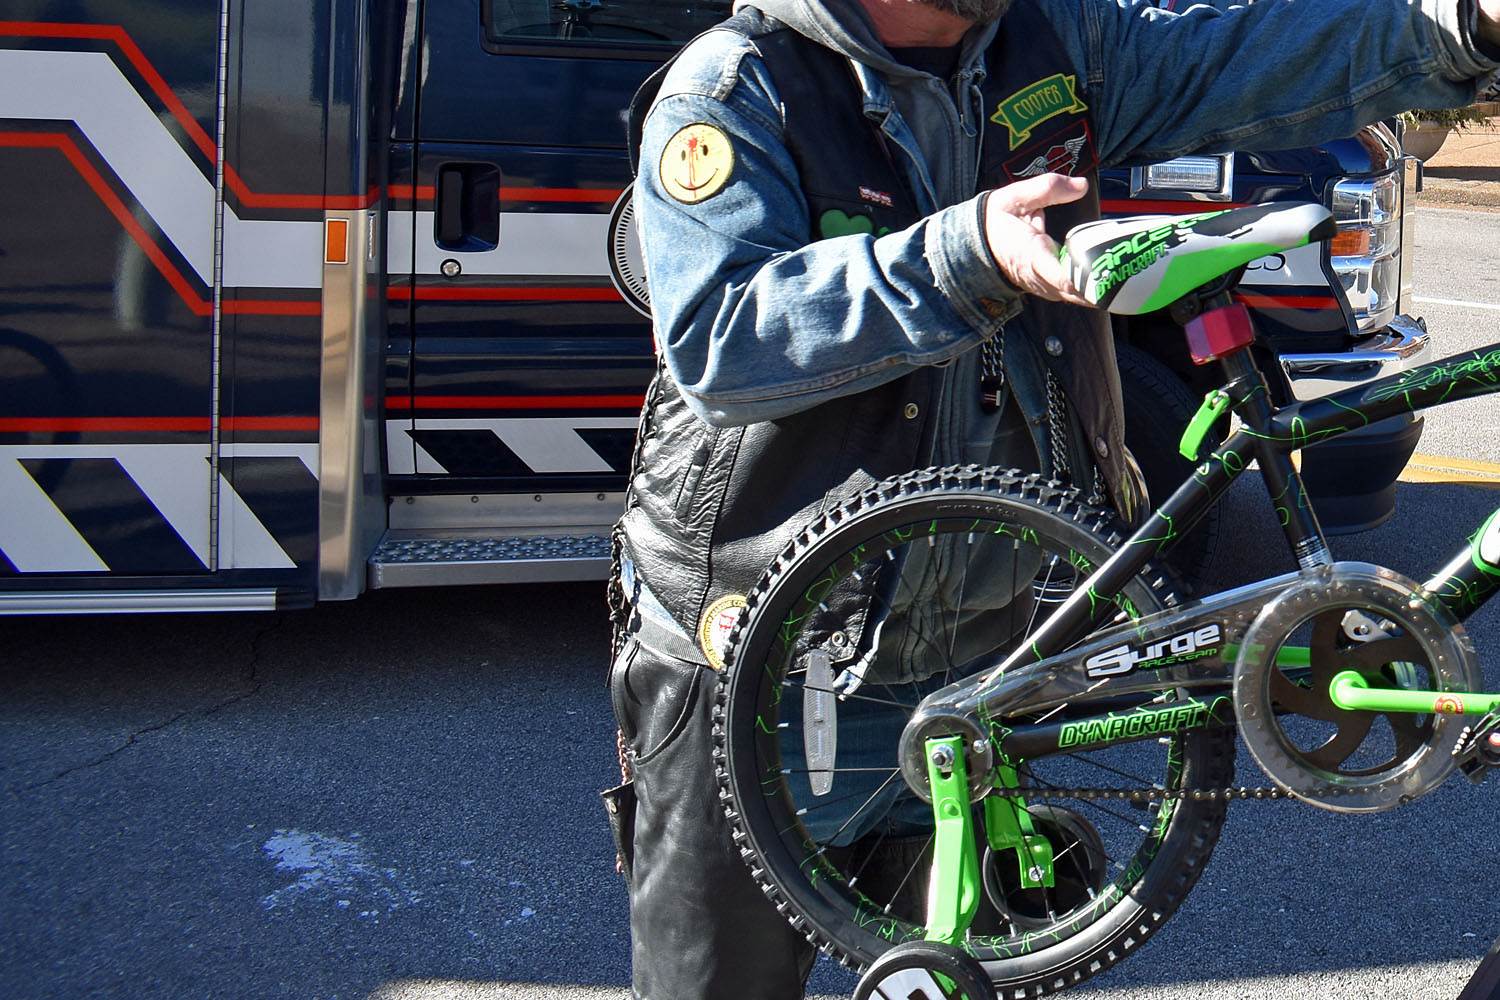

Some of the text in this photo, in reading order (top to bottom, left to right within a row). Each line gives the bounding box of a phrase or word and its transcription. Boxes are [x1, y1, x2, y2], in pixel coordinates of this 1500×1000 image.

[1013, 84, 1063, 120] COOTER
[1095, 241, 1167, 300] DYNACRAFT
[1086, 624, 1221, 677] Surge
[1058, 702, 1204, 749] DYNACRAFT
